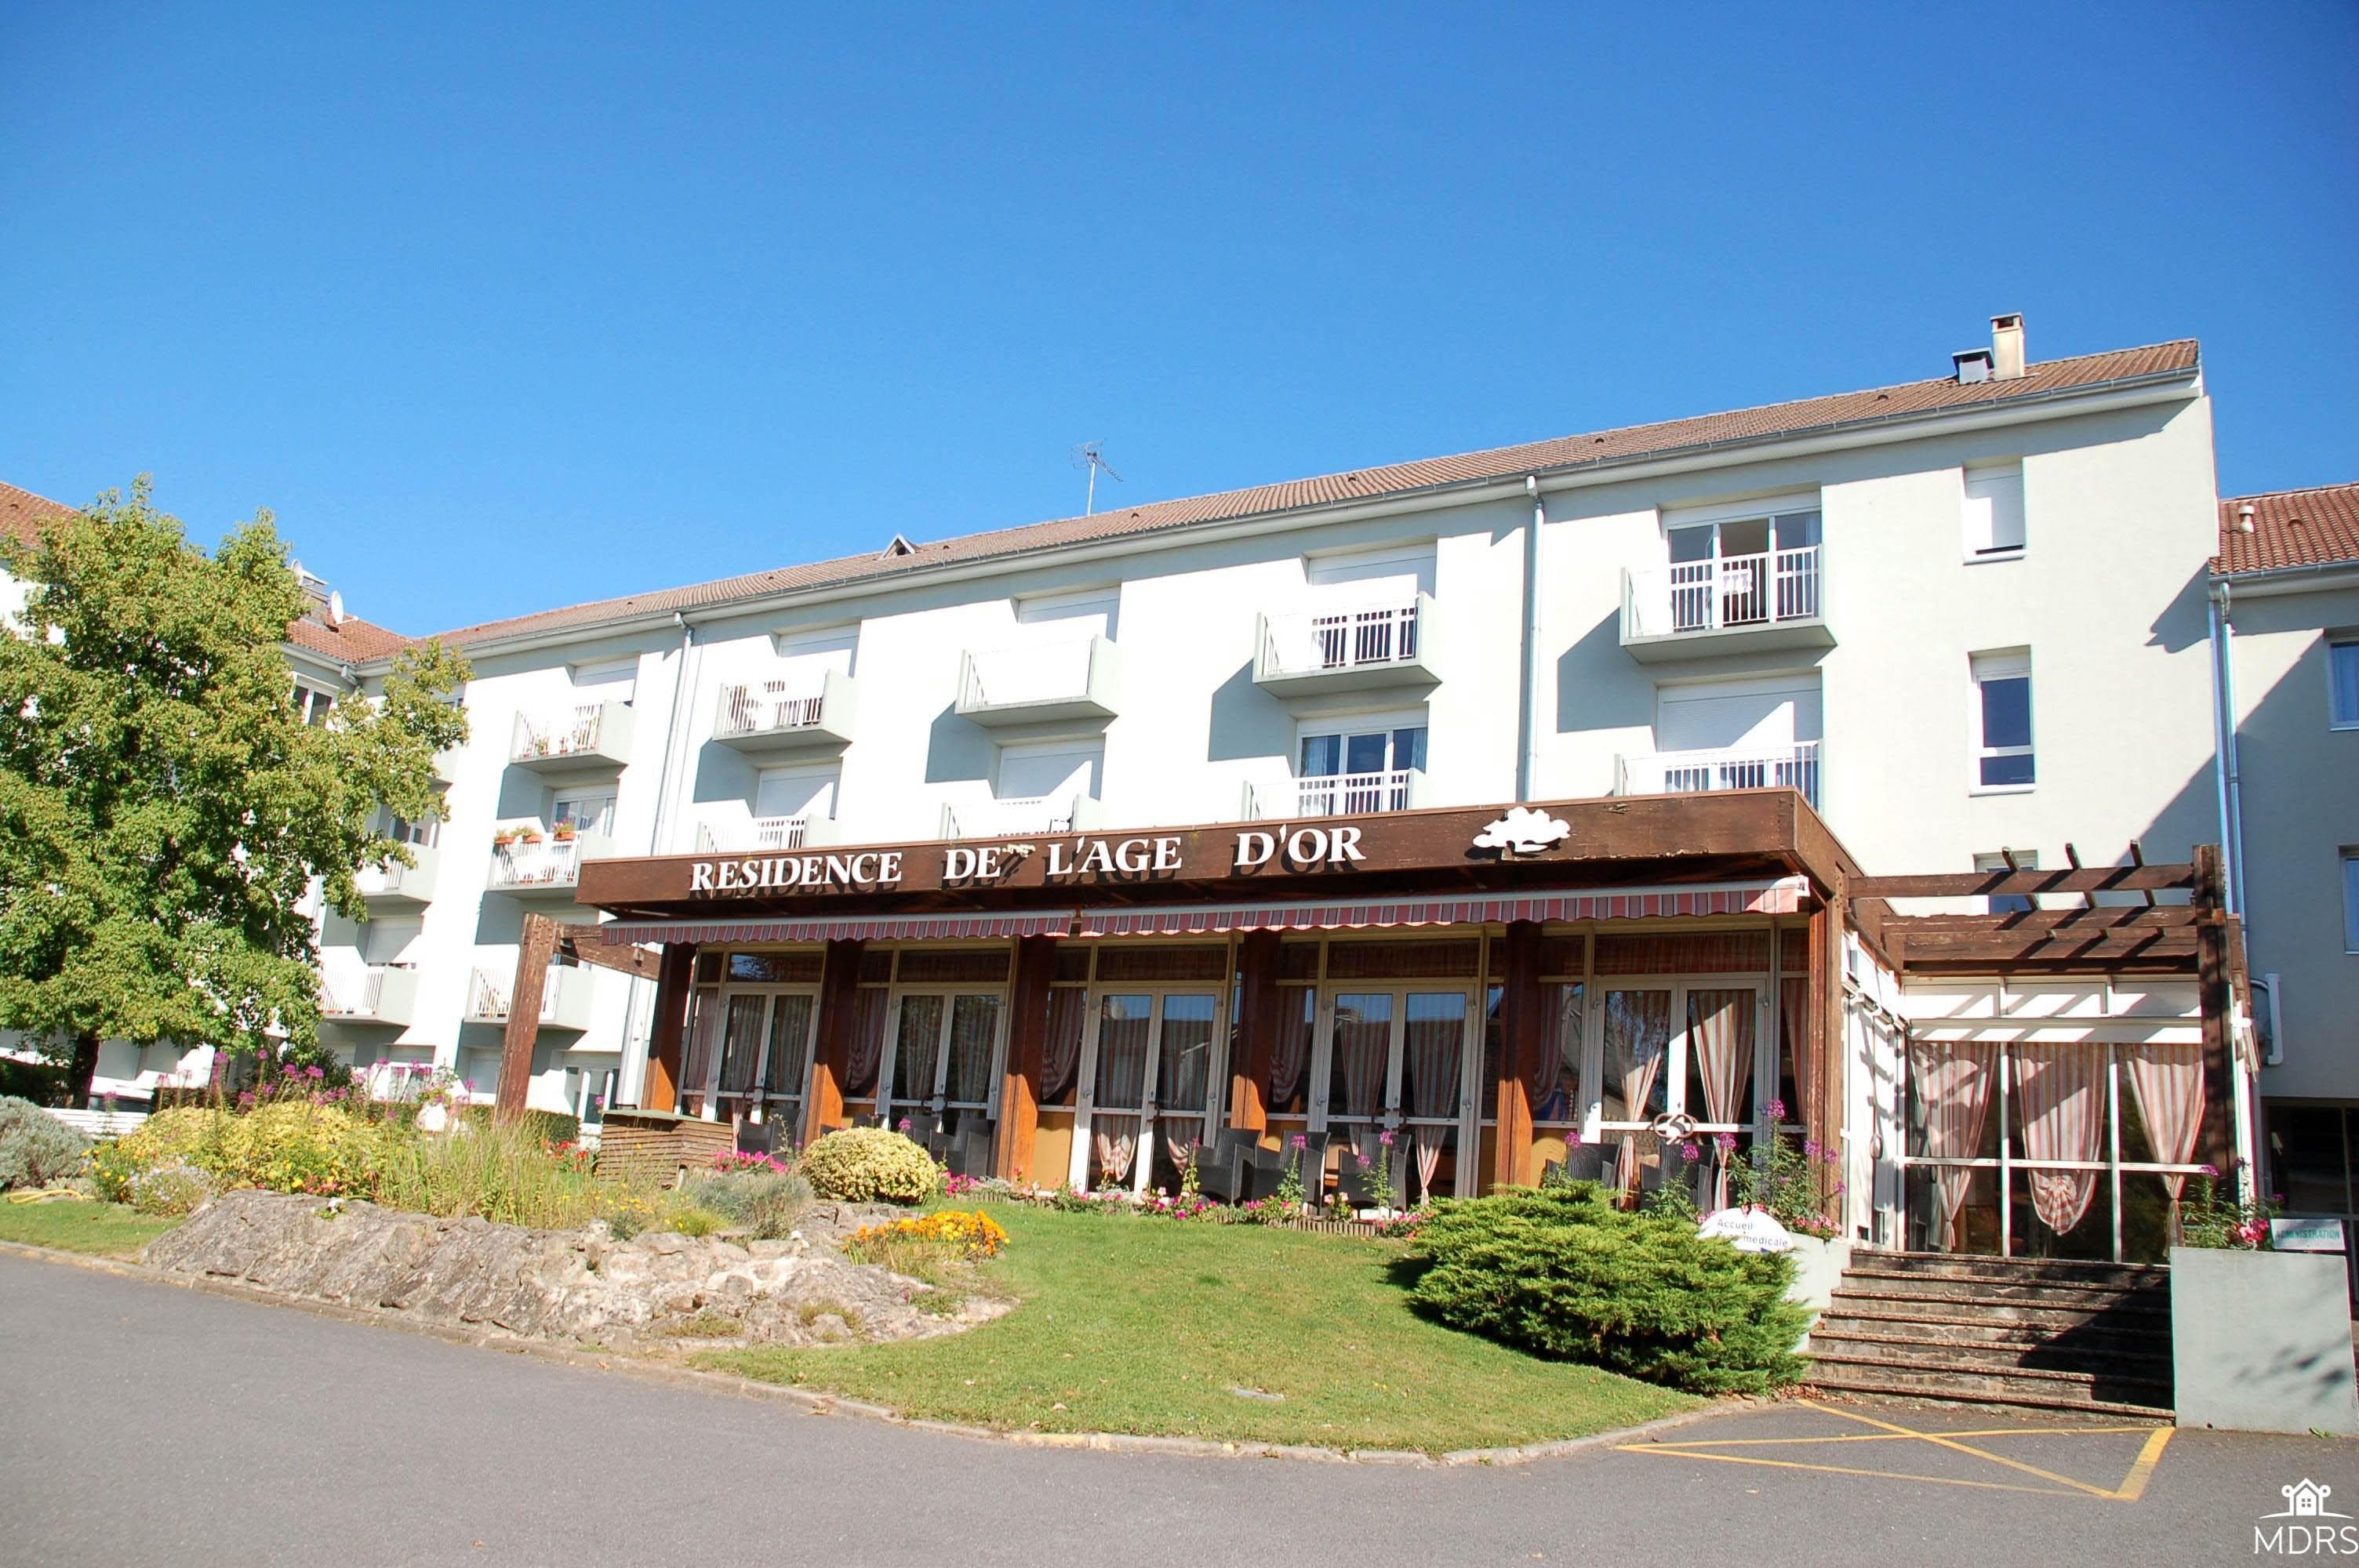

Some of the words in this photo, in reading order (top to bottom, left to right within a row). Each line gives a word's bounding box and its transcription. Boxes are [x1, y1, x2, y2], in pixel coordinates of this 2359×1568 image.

[689, 851, 903, 891] RESIDENCE
[943, 846, 1001, 880] DE
[1046, 836, 1183, 876] L'AGE
[1234, 824, 1367, 866] D'OR
[1717, 1218, 1754, 1230] Accueil
